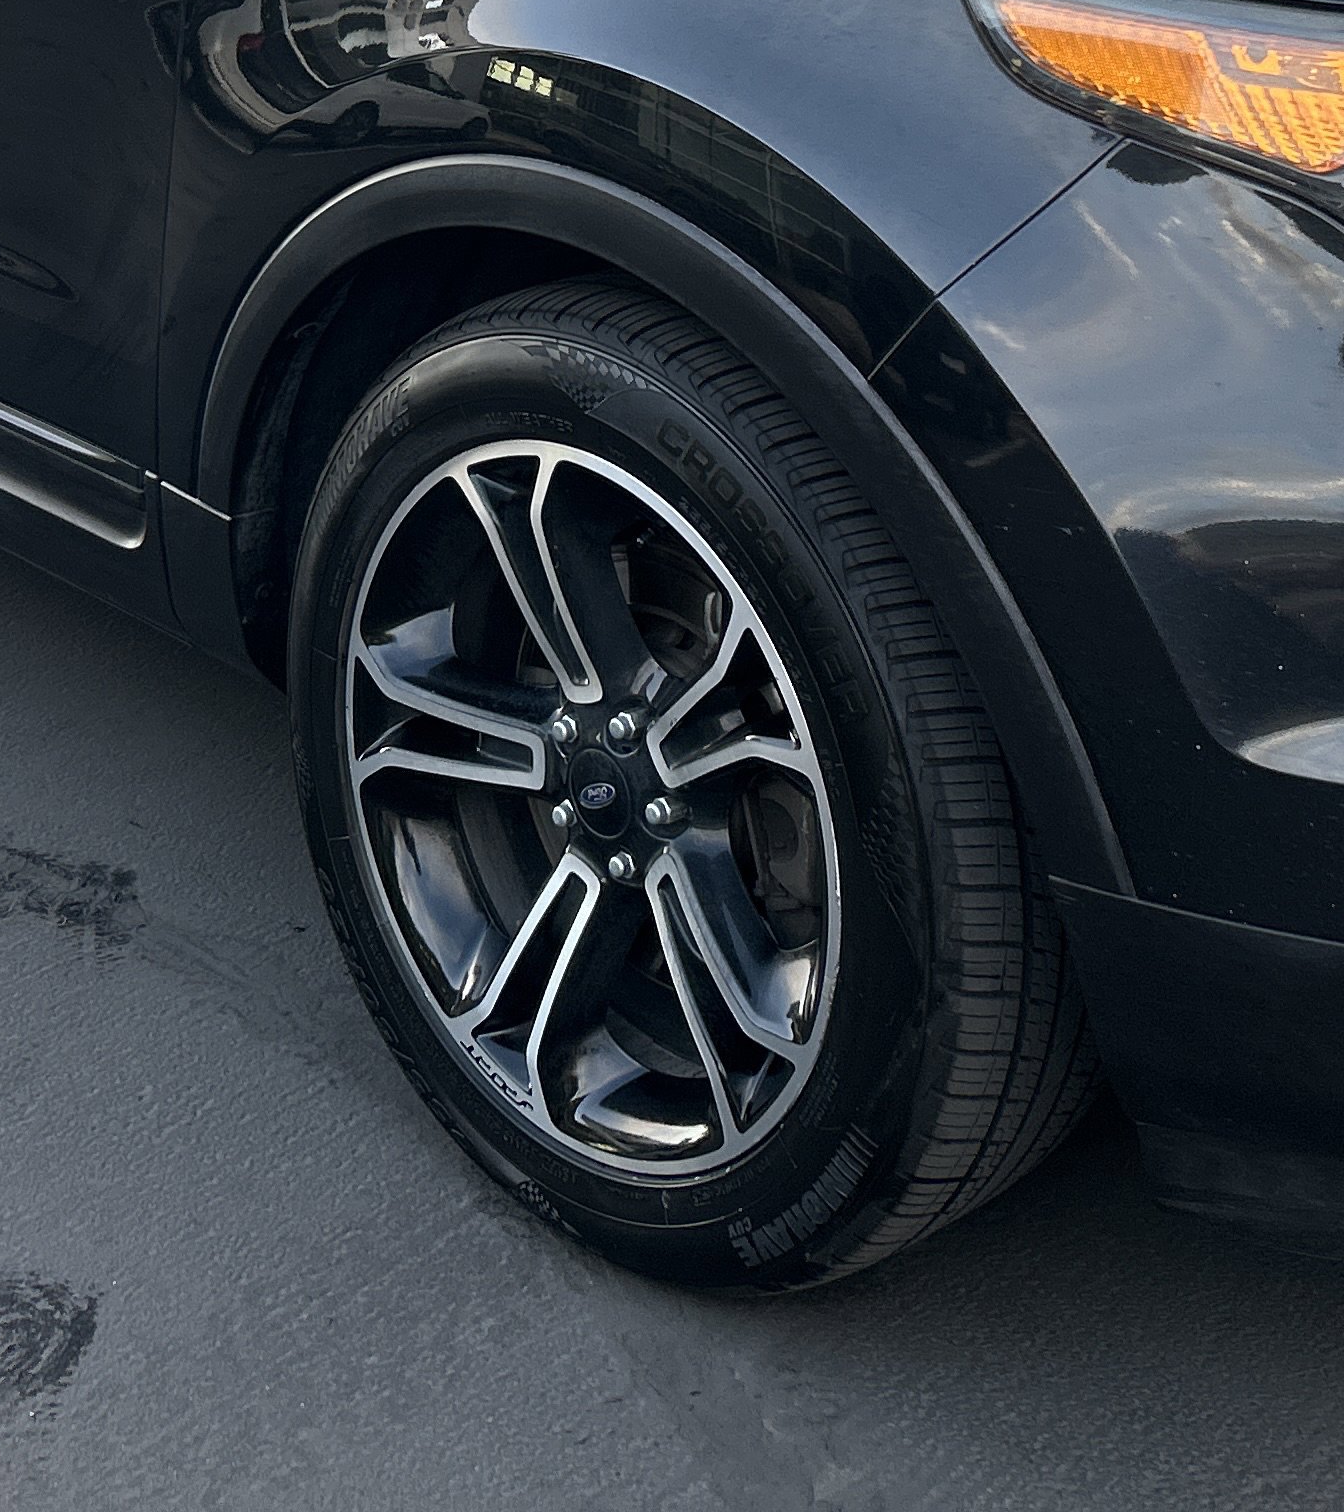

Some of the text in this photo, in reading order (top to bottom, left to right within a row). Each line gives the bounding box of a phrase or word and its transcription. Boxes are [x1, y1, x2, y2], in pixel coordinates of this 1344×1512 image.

[656, 417, 872, 721] CROSSOVER
[587, 786, 607, 801] Ford
[459, 1040, 534, 1110] SPORT
[727, 1215, 753, 1239] CUV
[730, 1157, 857, 1268] MOHAVE
